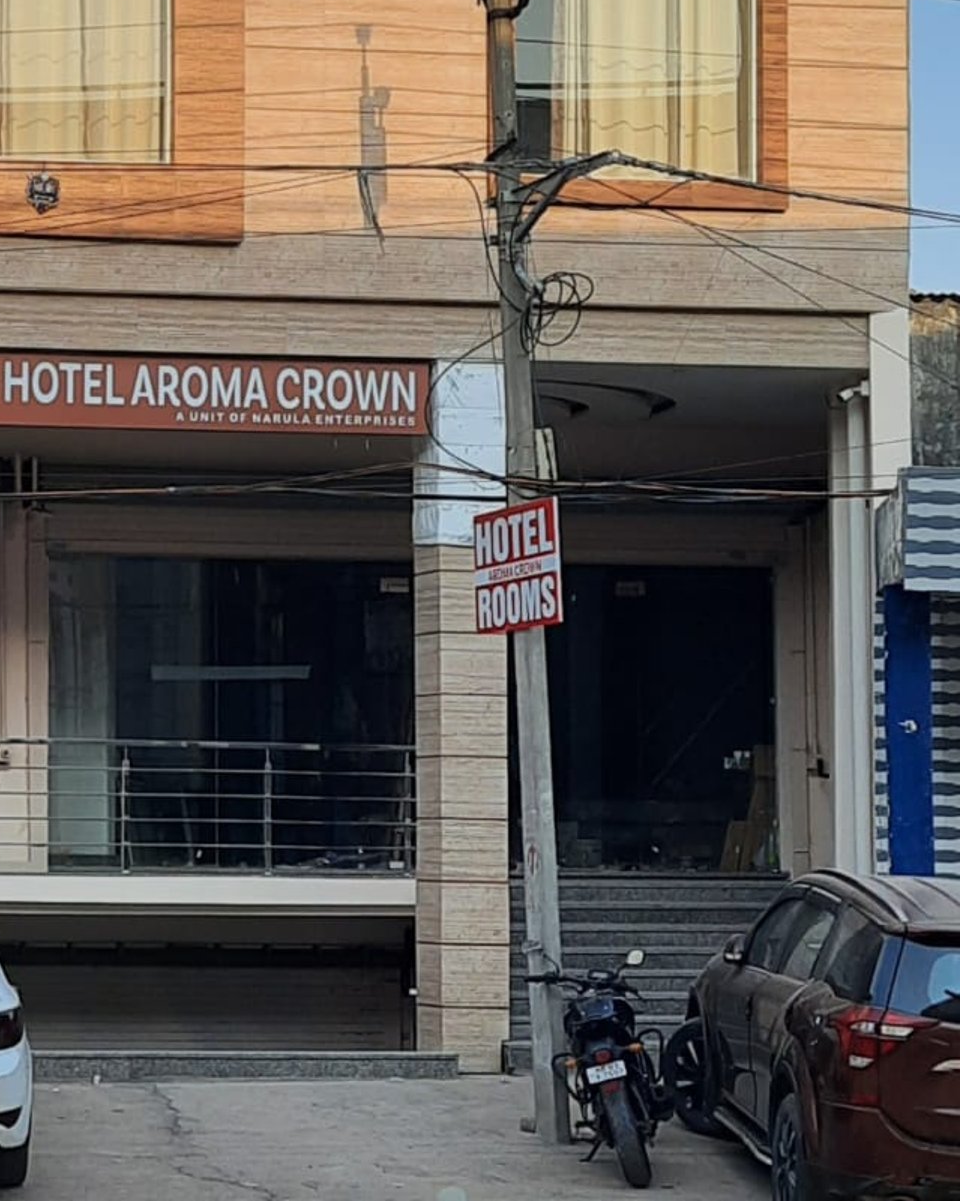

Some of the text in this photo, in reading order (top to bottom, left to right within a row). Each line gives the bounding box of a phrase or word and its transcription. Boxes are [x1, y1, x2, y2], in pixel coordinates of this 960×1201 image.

[3, 361, 416, 412] HOTEL AROMA CROWN
[176, 411, 416, 427] A UNIT OF NARULA ENTERPRISES
[475, 507, 554, 567] HOTEL
[478, 575, 557, 629] ROOMS
